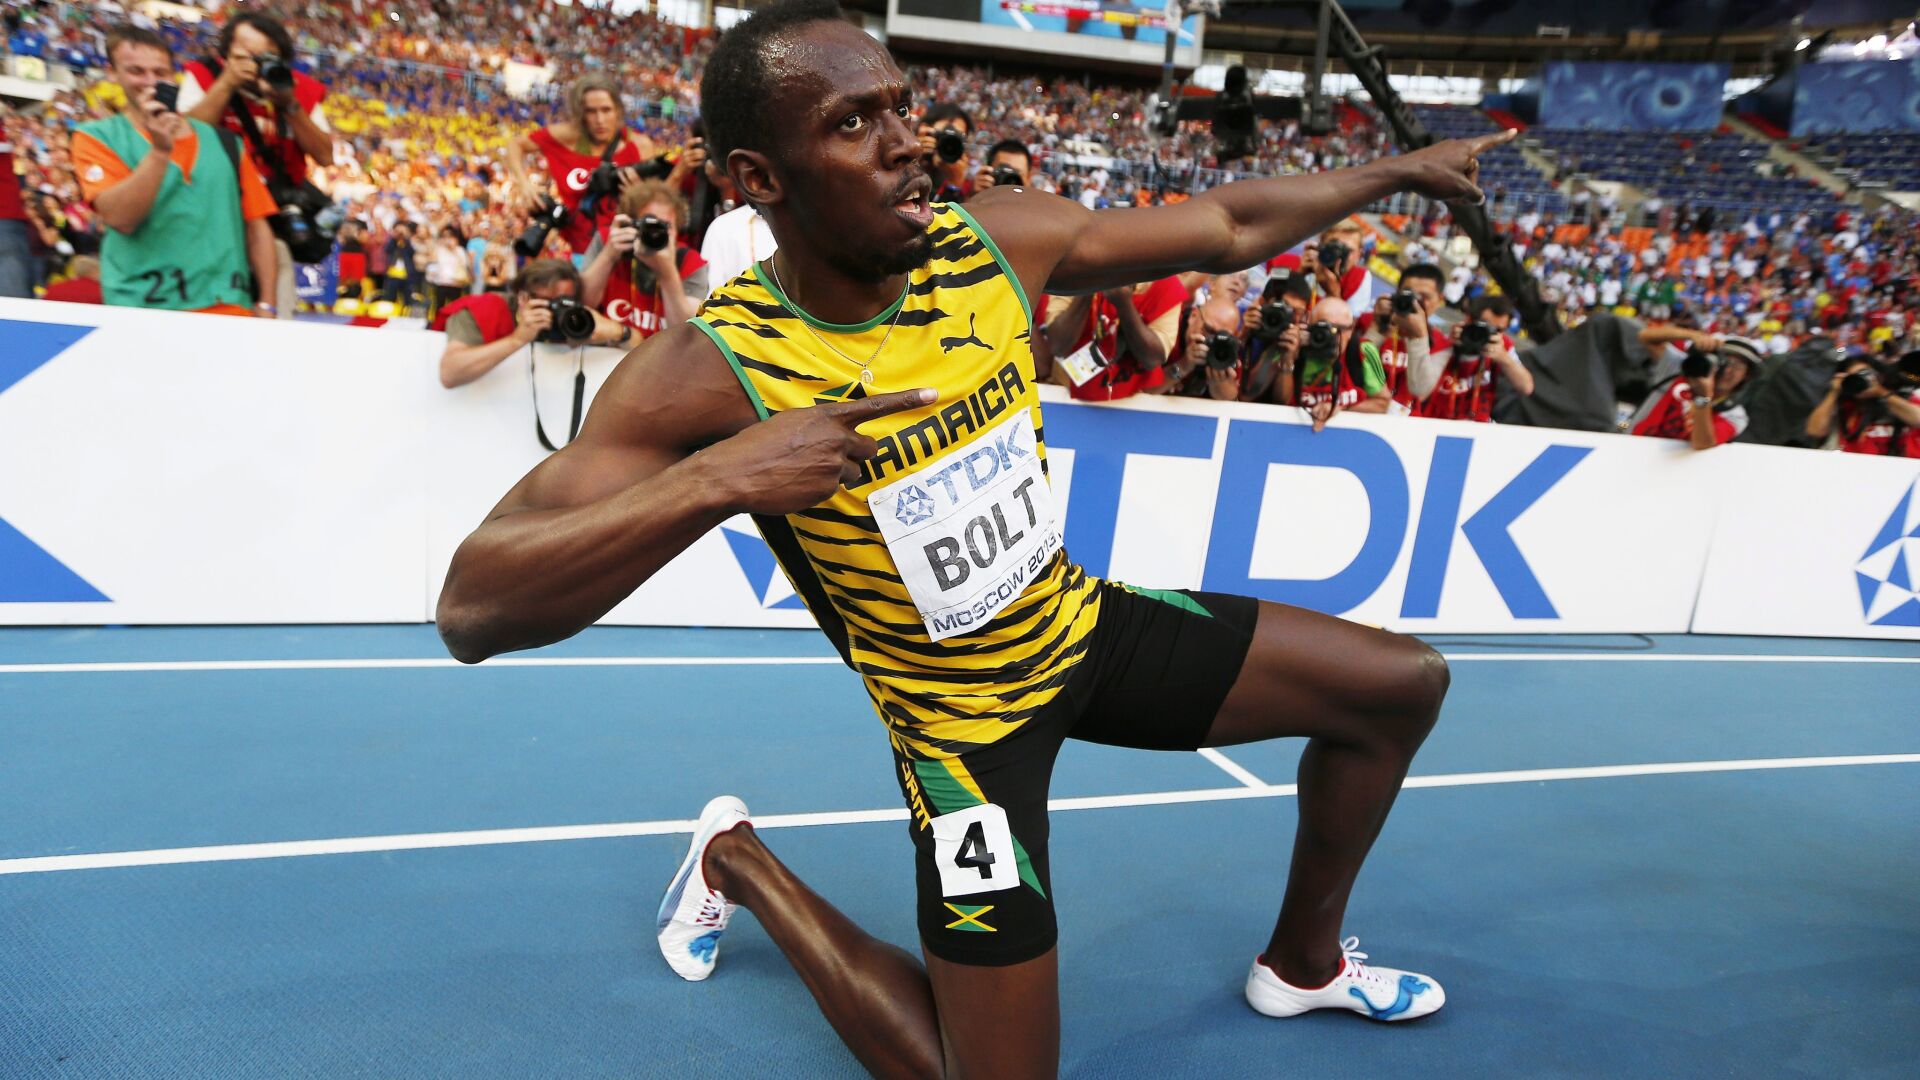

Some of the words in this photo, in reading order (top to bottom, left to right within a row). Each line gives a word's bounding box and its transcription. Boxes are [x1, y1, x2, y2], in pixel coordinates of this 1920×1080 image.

[141, 268, 189, 304] 21
[925, 421, 1030, 506] TDK
[922, 476, 1037, 592] BOLT
[1043, 402, 1595, 620] TDK
[933, 566, 1024, 633] MOSCOW
[1027, 530, 1057, 574] 2013
[953, 820, 996, 880] 4
